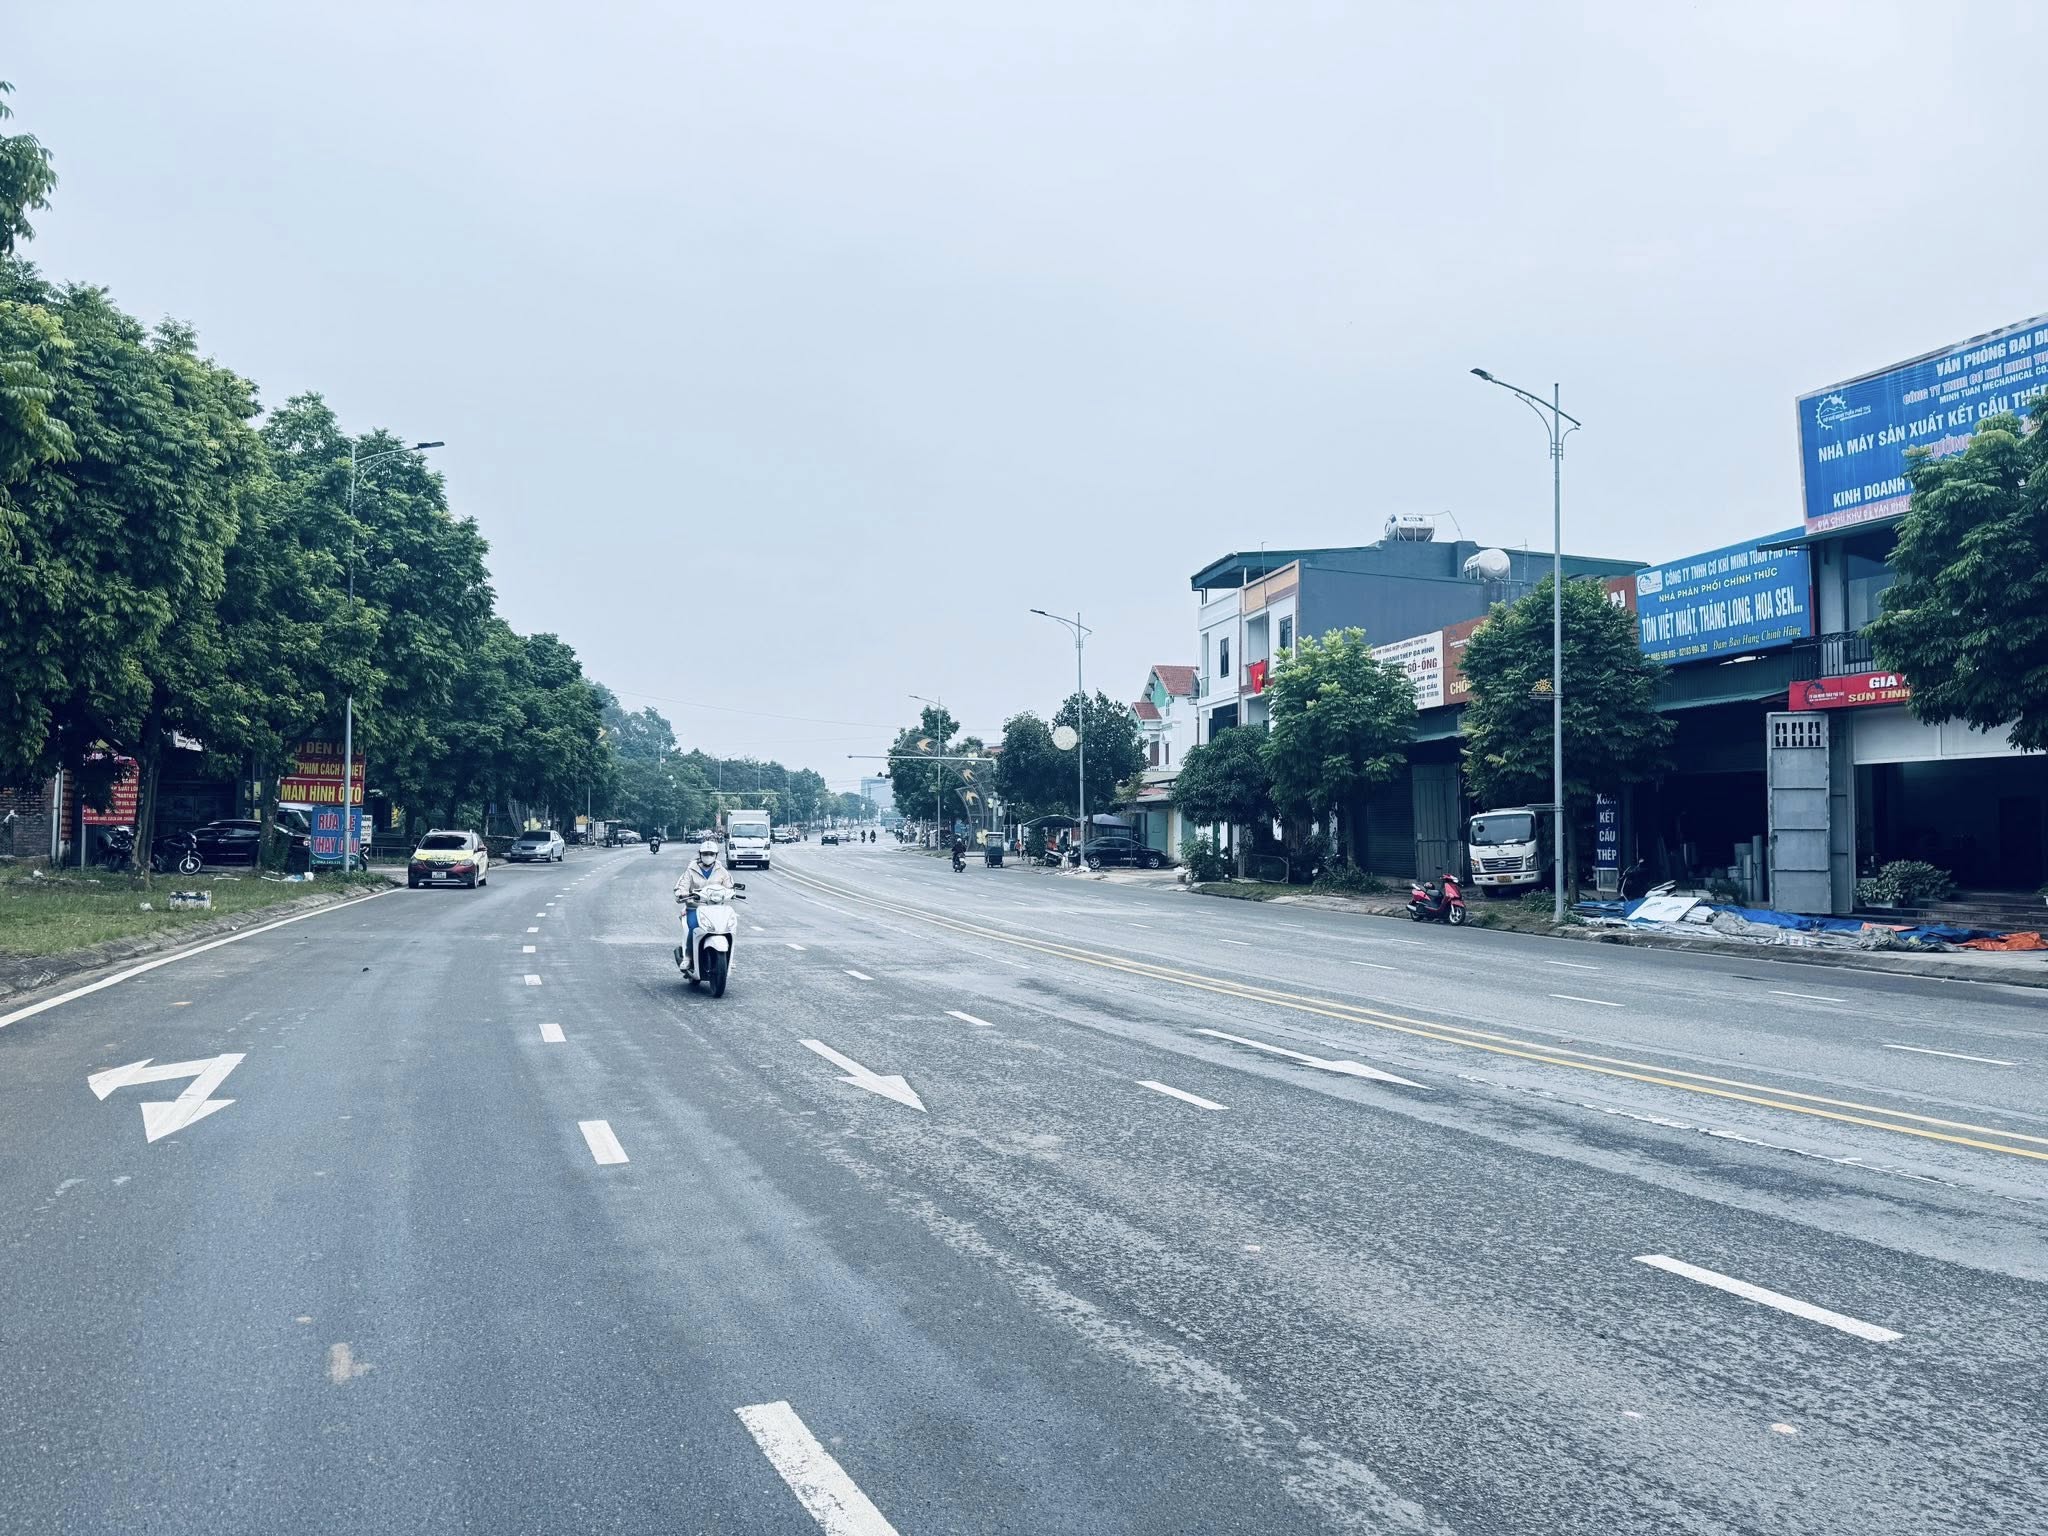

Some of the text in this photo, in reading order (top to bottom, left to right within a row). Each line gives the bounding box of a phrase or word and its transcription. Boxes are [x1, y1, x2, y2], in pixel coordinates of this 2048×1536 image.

[1936, 327, 2048, 376] VĂN PHÒNG ĐẠI DI
[1903, 387, 1928, 405] CÔNG
[1929, 384, 1941, 397] TY
[1942, 376, 1968, 394] TNHH
[2004, 356, 2032, 375] MINH
[1939, 393, 1960, 405] MINH
[1960, 386, 1981, 398] TUAN
[1982, 369, 2034, 391] MECHANICAL
[1818, 440, 1844, 463] NHÀ
[1846, 433, 1875, 456] MÁY
[1878, 423, 1906, 446] SẢN
[1909, 410, 1944, 438] XUẤT
[1947, 402, 1974, 427] KẾT
[1978, 391, 2009, 418] CẤU
[1833, 488, 1861, 508] KINH
[1864, 477, 1906, 500] DOANH
[1665, 569, 1682, 586] CÔNG
[1682, 566, 1690, 582] TY
[1691, 562, 1707, 580] TNHH
[1708, 559, 1717, 576] CƠ
[1718, 554, 1729, 573] KHÍ
[1730, 551, 1748, 570] MINH
[1658, 591, 1676, 602] NHÀ
[1677, 585, 1699, 599] PHÂN
[1701, 578, 1721, 593] PHỐI
[1723, 573, 1751, 587] CHÍNH
[1754, 567, 1778, 580] THỨC
[1641, 585, 1803, 645] TÔN VIỆT NHẬT, THĂNG LONG, HOA SEN...
[1869, 675, 1898, 689] GIA
[1848, 691, 1876, 703] SƠN
[299, 762, 319, 775] PHIM
[320, 761, 340, 775] CÁCH
[281, 781, 306, 801] MÀN
[309, 782, 336, 802] HÌNH
[1600, 808, 1615, 823] KẾT
[313, 836, 337, 854] THAY
[1599, 827, 1616, 842] CẤU
[1597, 847, 1617, 861] THÉP
